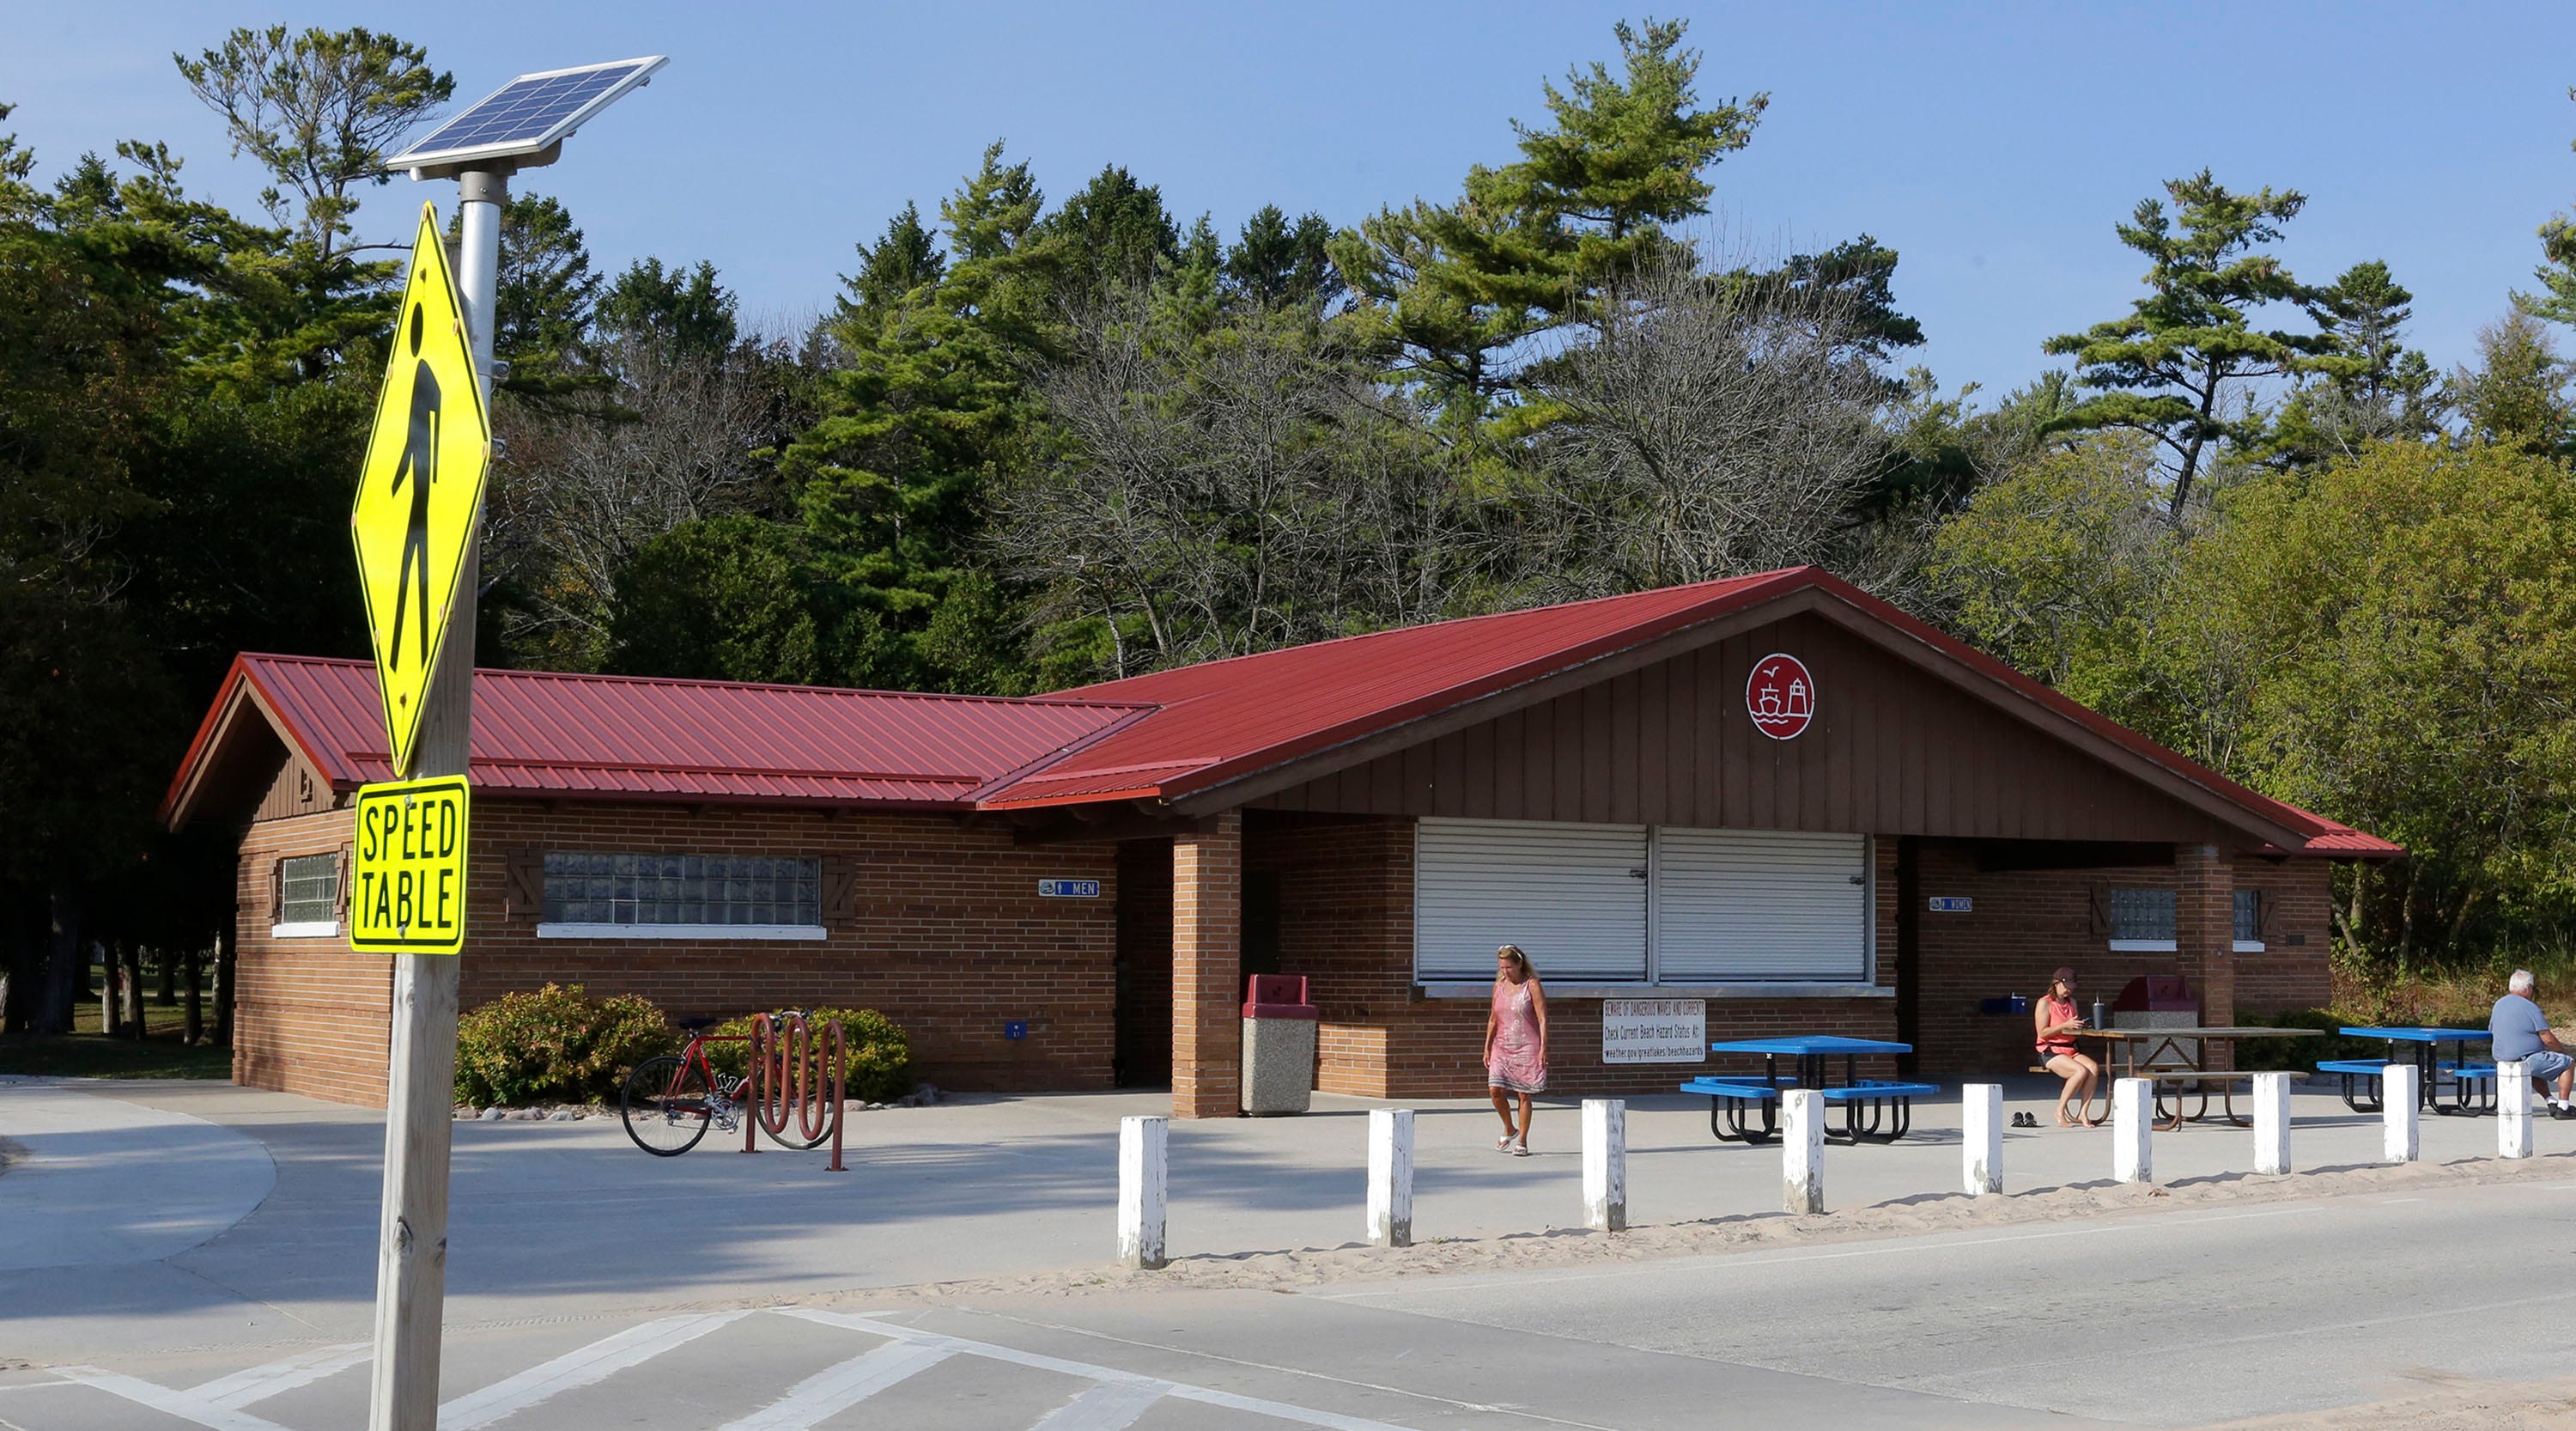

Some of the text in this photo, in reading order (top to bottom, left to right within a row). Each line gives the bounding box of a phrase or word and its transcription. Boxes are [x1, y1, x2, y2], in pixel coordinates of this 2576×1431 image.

[363, 799, 456, 862] SPEED
[1072, 882, 1095, 894] MEN
[362, 868, 453, 929] TABLE
[1950, 899, 1971, 910] WOMEN
[1605, 1001, 1704, 1016] BEWARE OF DANGEROUS WAVES AND CURRENTS
[1605, 1026, 1619, 1041] Check
[1620, 1025, 1639, 1040] Current
[1640, 1024, 1655, 1039] Beach
[1656, 1023, 1673, 1038] Hazard
[1674, 1023, 1690, 1038] Status
